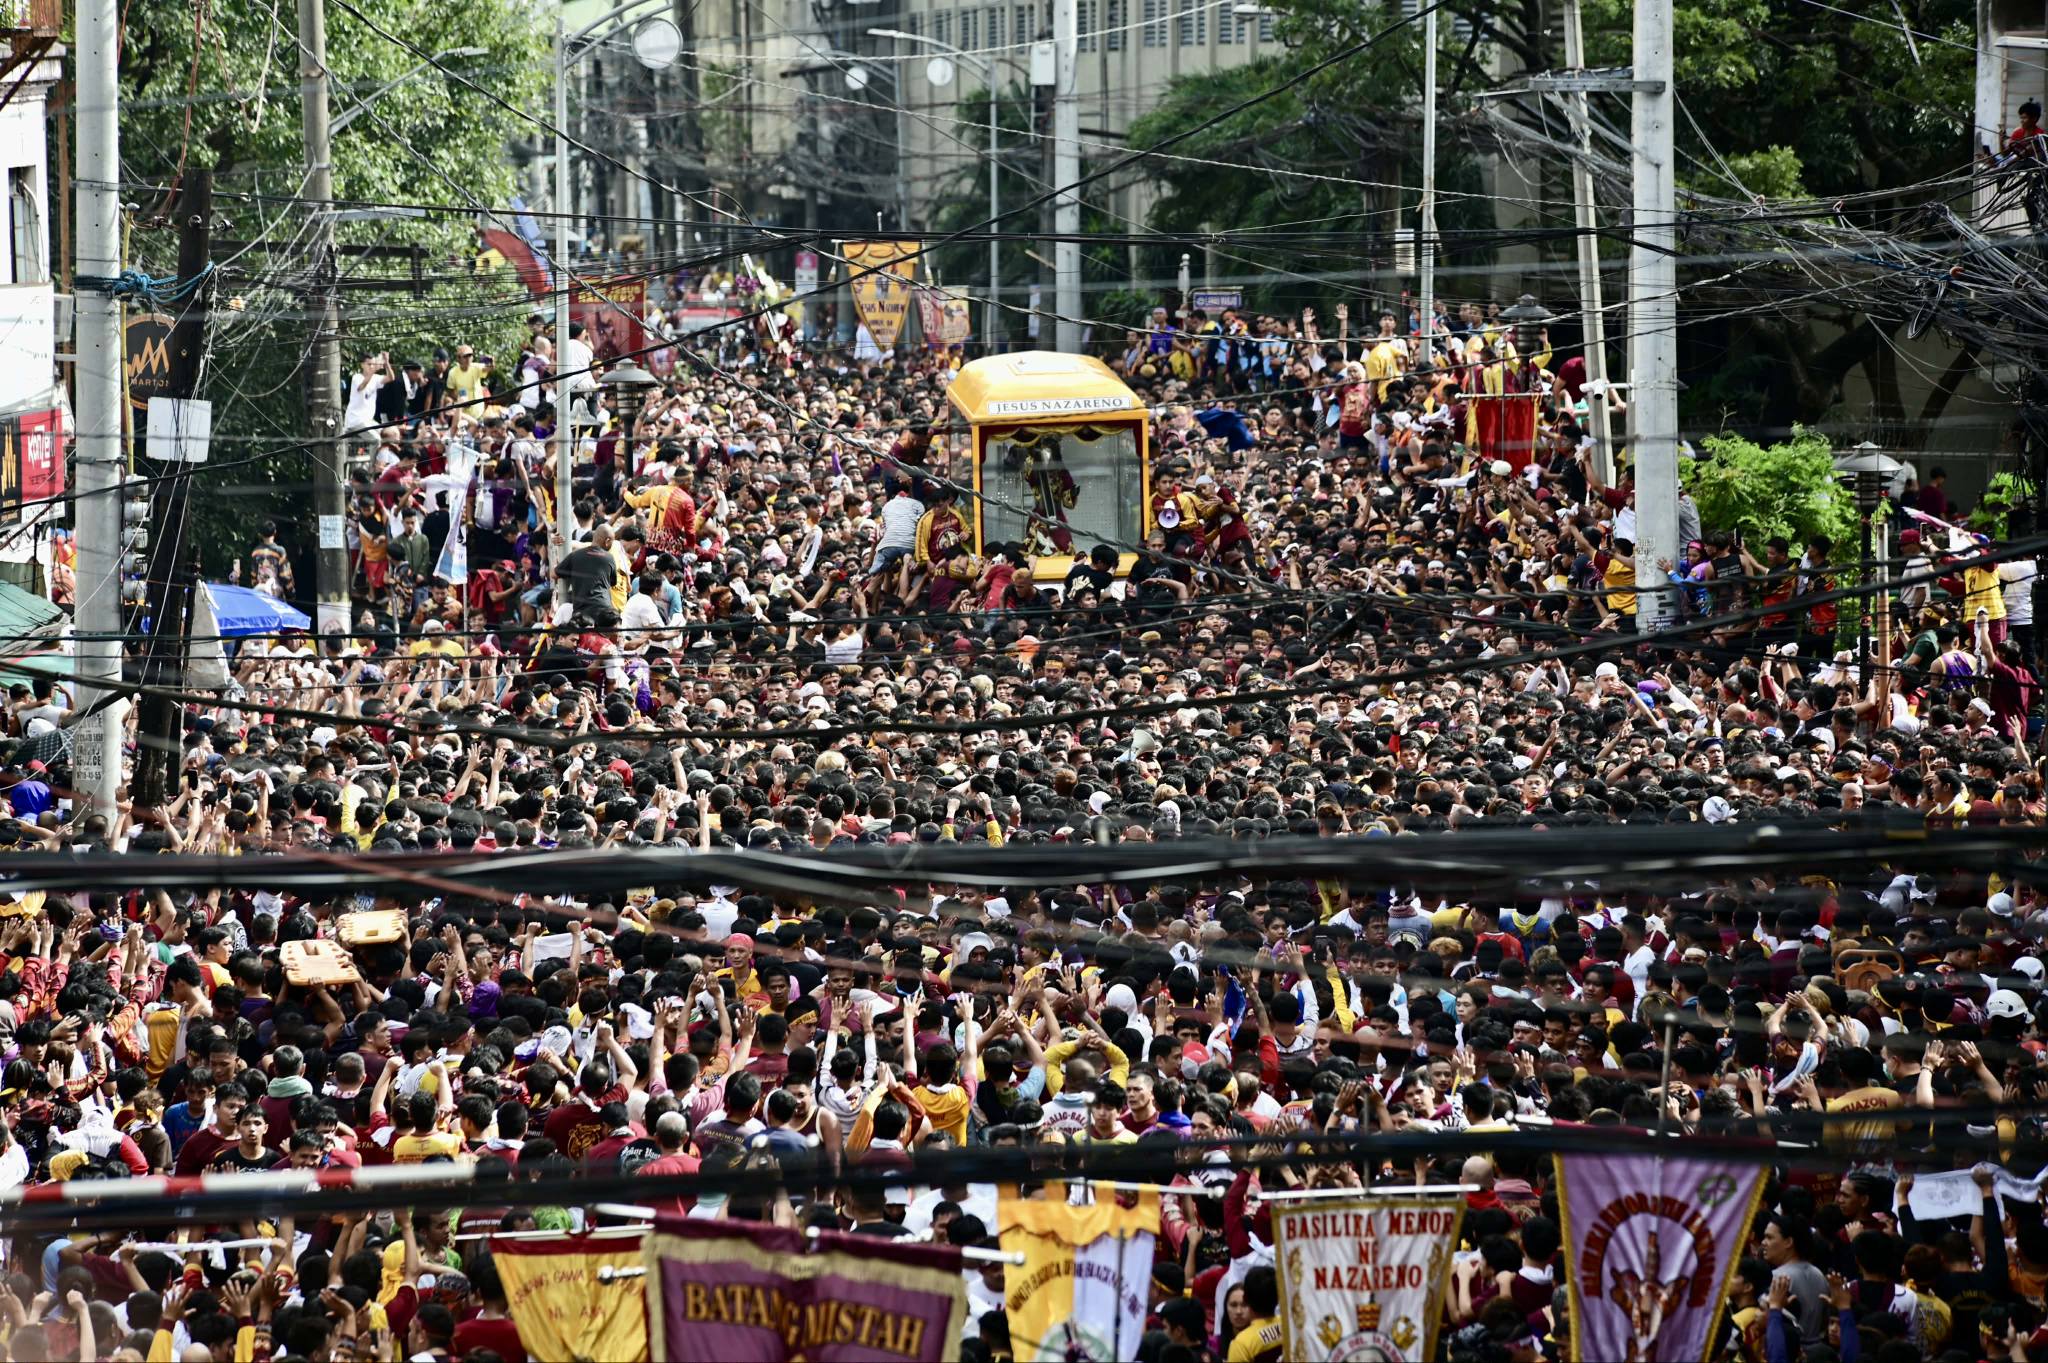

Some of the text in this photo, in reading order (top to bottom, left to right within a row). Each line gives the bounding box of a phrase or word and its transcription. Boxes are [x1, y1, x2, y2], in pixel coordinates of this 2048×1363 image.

[997, 398, 1123, 414] JESUS NAZARENO
[1388, 1211, 1455, 1236] MENOR
[1314, 1264, 1422, 1291] NAZARENO
[802, 1300, 926, 1359] MISTAH
